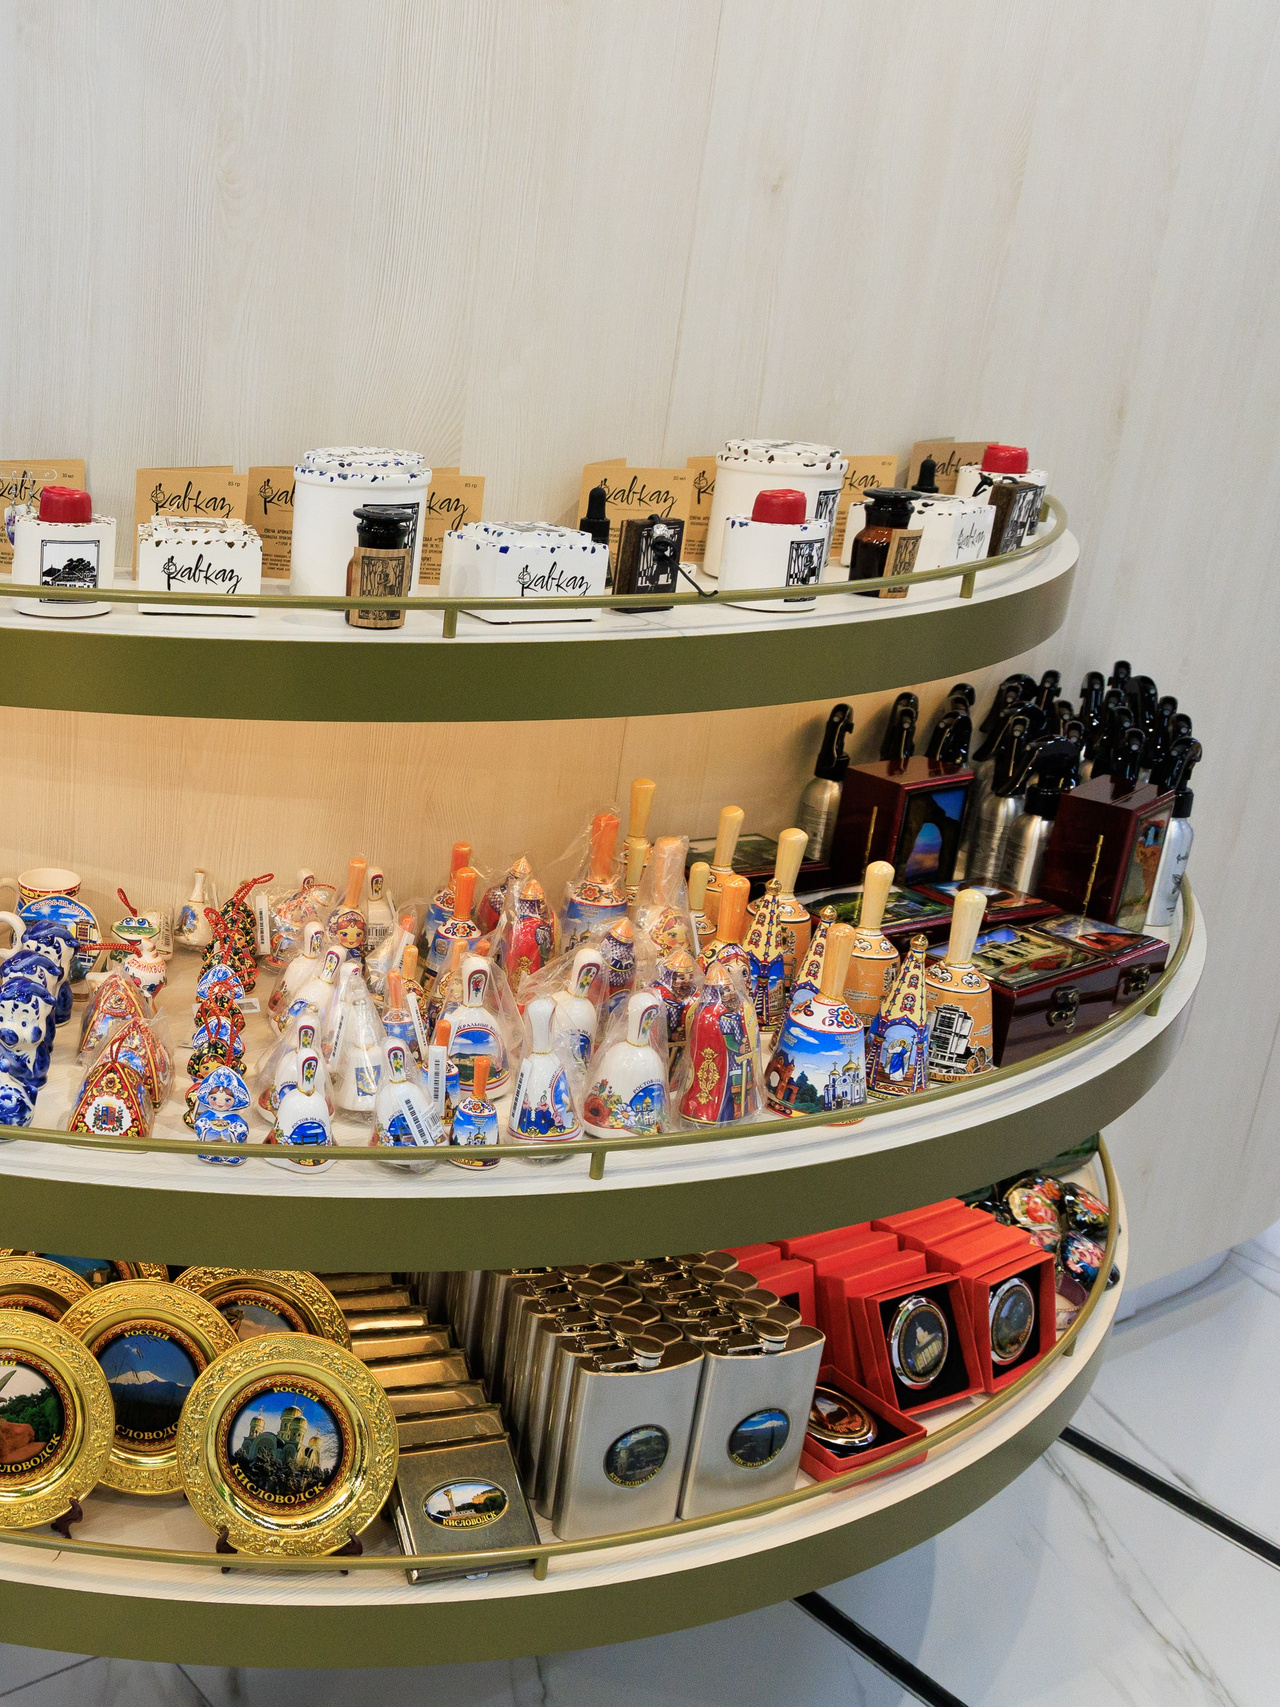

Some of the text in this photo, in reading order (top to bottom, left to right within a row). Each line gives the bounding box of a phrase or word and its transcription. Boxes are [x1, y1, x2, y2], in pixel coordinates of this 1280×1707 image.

[236, 1299, 281, 1316] РОССИЯ
[124, 1329, 170, 1341] РОССИЯ
[272, 1386, 320, 1403] РОССИЯ
[231, 1462, 326, 1504] КИСЛОВОДСК
[442, 1511, 497, 1527] КИСЛОВОДСК
